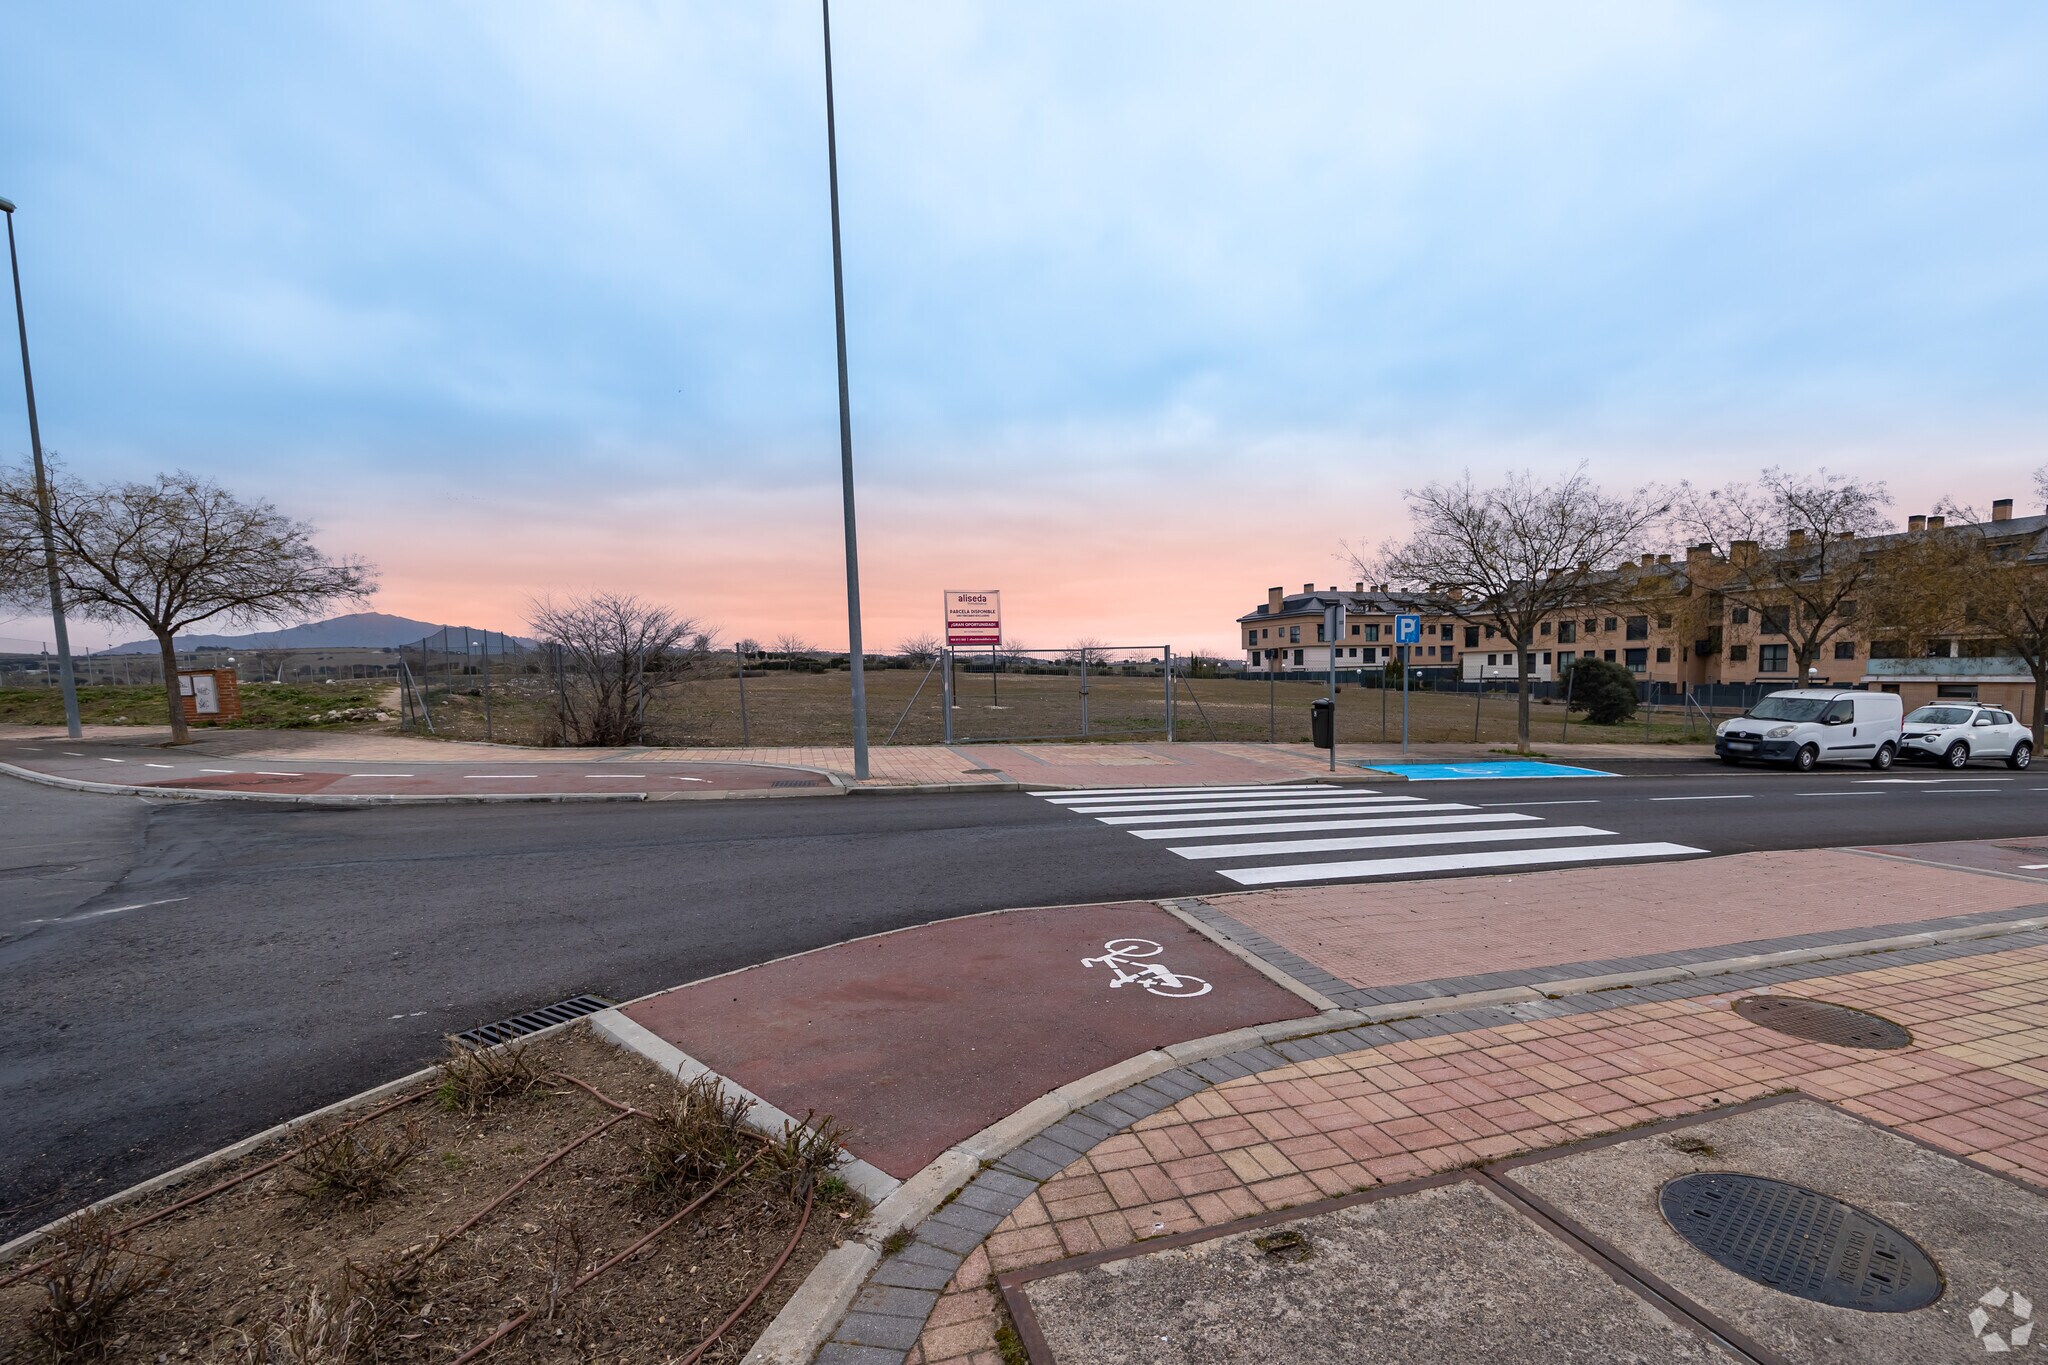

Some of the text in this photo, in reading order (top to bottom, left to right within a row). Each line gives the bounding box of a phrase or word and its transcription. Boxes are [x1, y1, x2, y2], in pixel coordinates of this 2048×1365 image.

[958, 594, 987, 602] aliseda
[1401, 618, 1415, 640] P
[1834, 1230, 1868, 1285] REGISTRO
